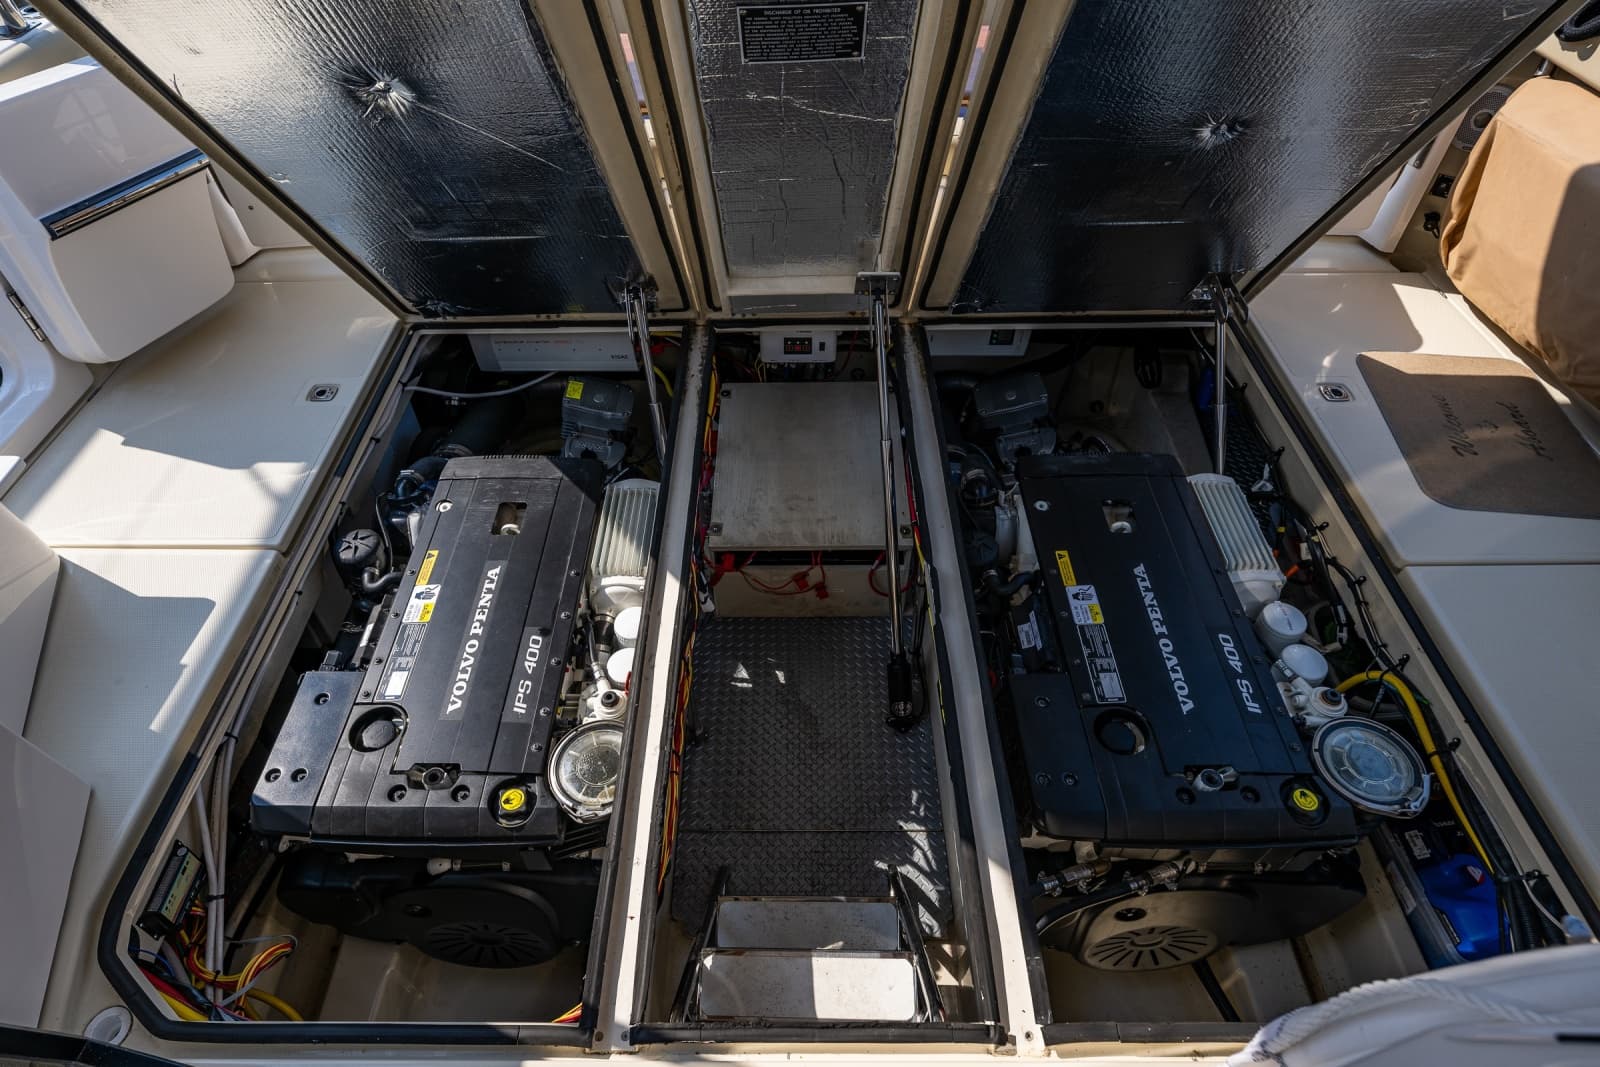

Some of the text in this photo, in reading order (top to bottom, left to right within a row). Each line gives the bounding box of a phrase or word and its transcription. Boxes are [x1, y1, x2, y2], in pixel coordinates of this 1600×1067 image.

[446, 565, 501, 714] VOLVO PENTA
[512, 635, 543, 714] IPS 400
[1133, 563, 1195, 715] VOLVO PENTA
[1218, 633, 1262, 714] IPS 400
